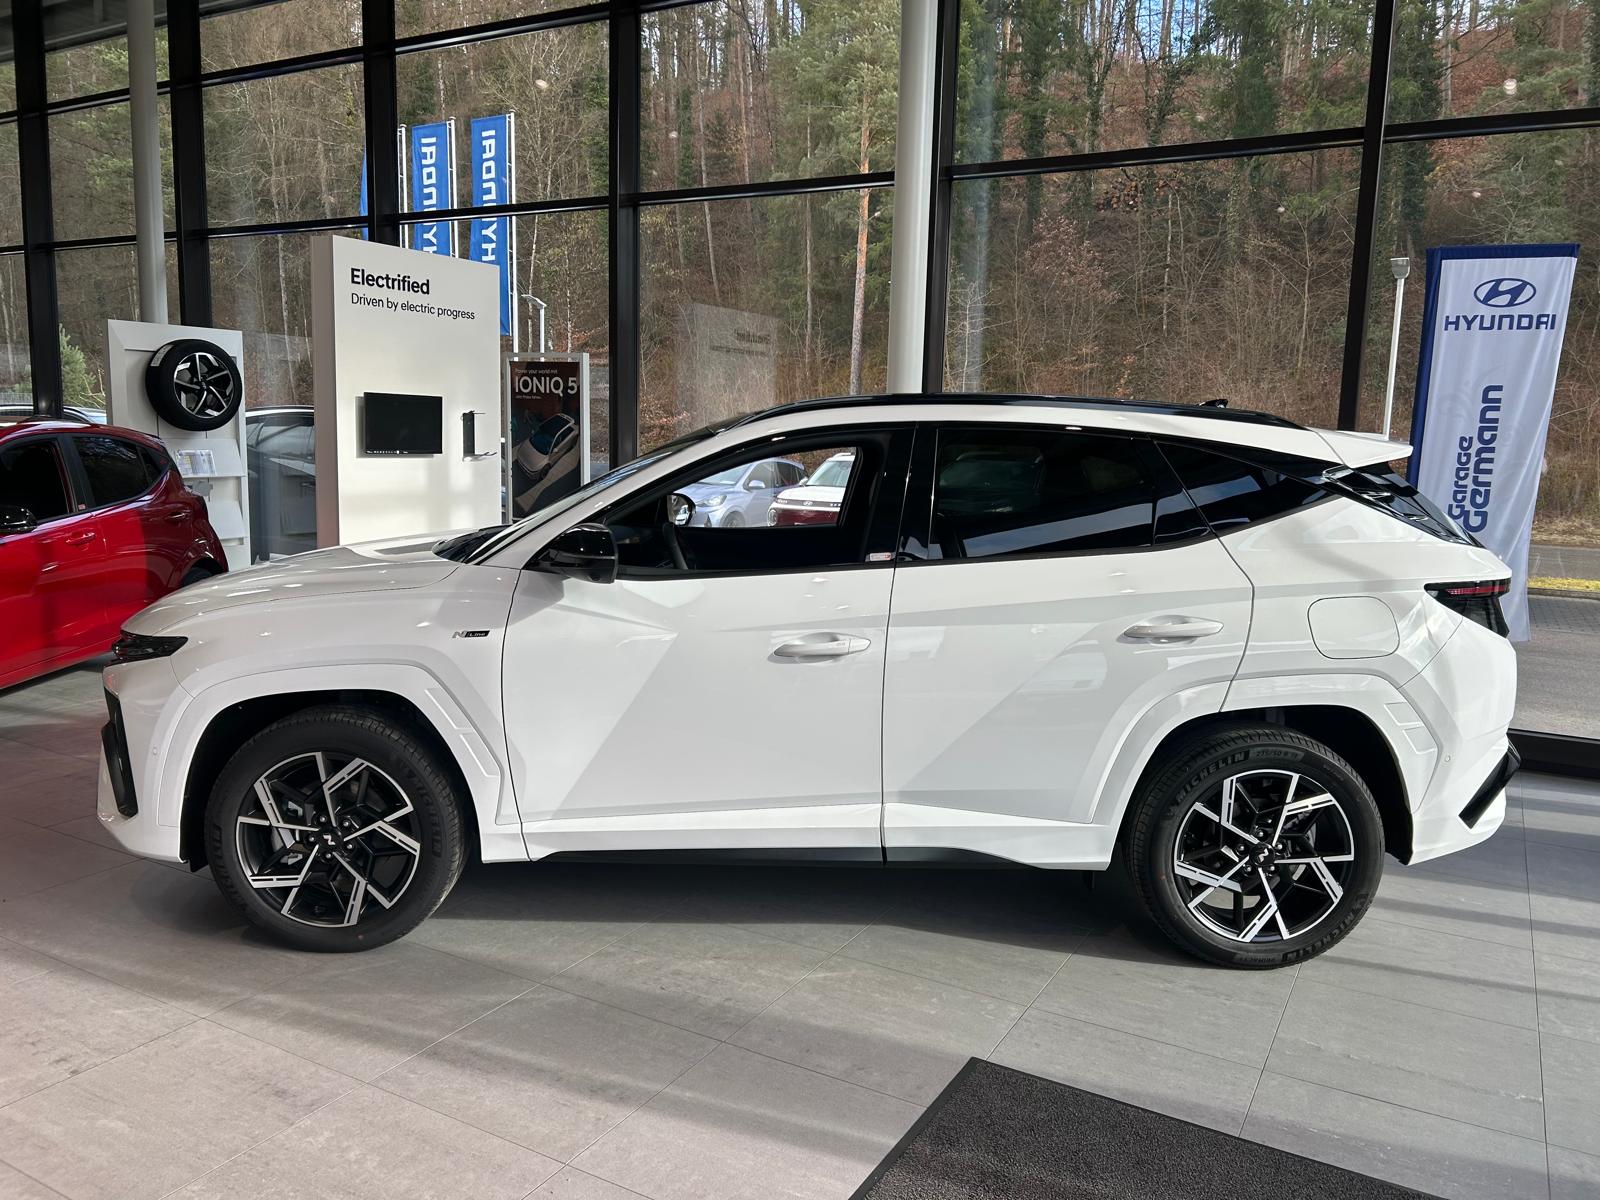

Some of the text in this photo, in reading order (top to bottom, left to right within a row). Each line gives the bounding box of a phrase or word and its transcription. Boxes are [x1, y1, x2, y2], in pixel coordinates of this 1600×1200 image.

[350, 267, 430, 295] Electrified
[351, 292, 476, 320] Driven by electric progress
[1444, 313, 1557, 331] HYUNDAI
[515, 376, 578, 397] IONIQ 5
[1463, 384, 1504, 533] Germann
[1448, 435, 1473, 520] Garage
[1175, 751, 1246, 802] MICHELIN
